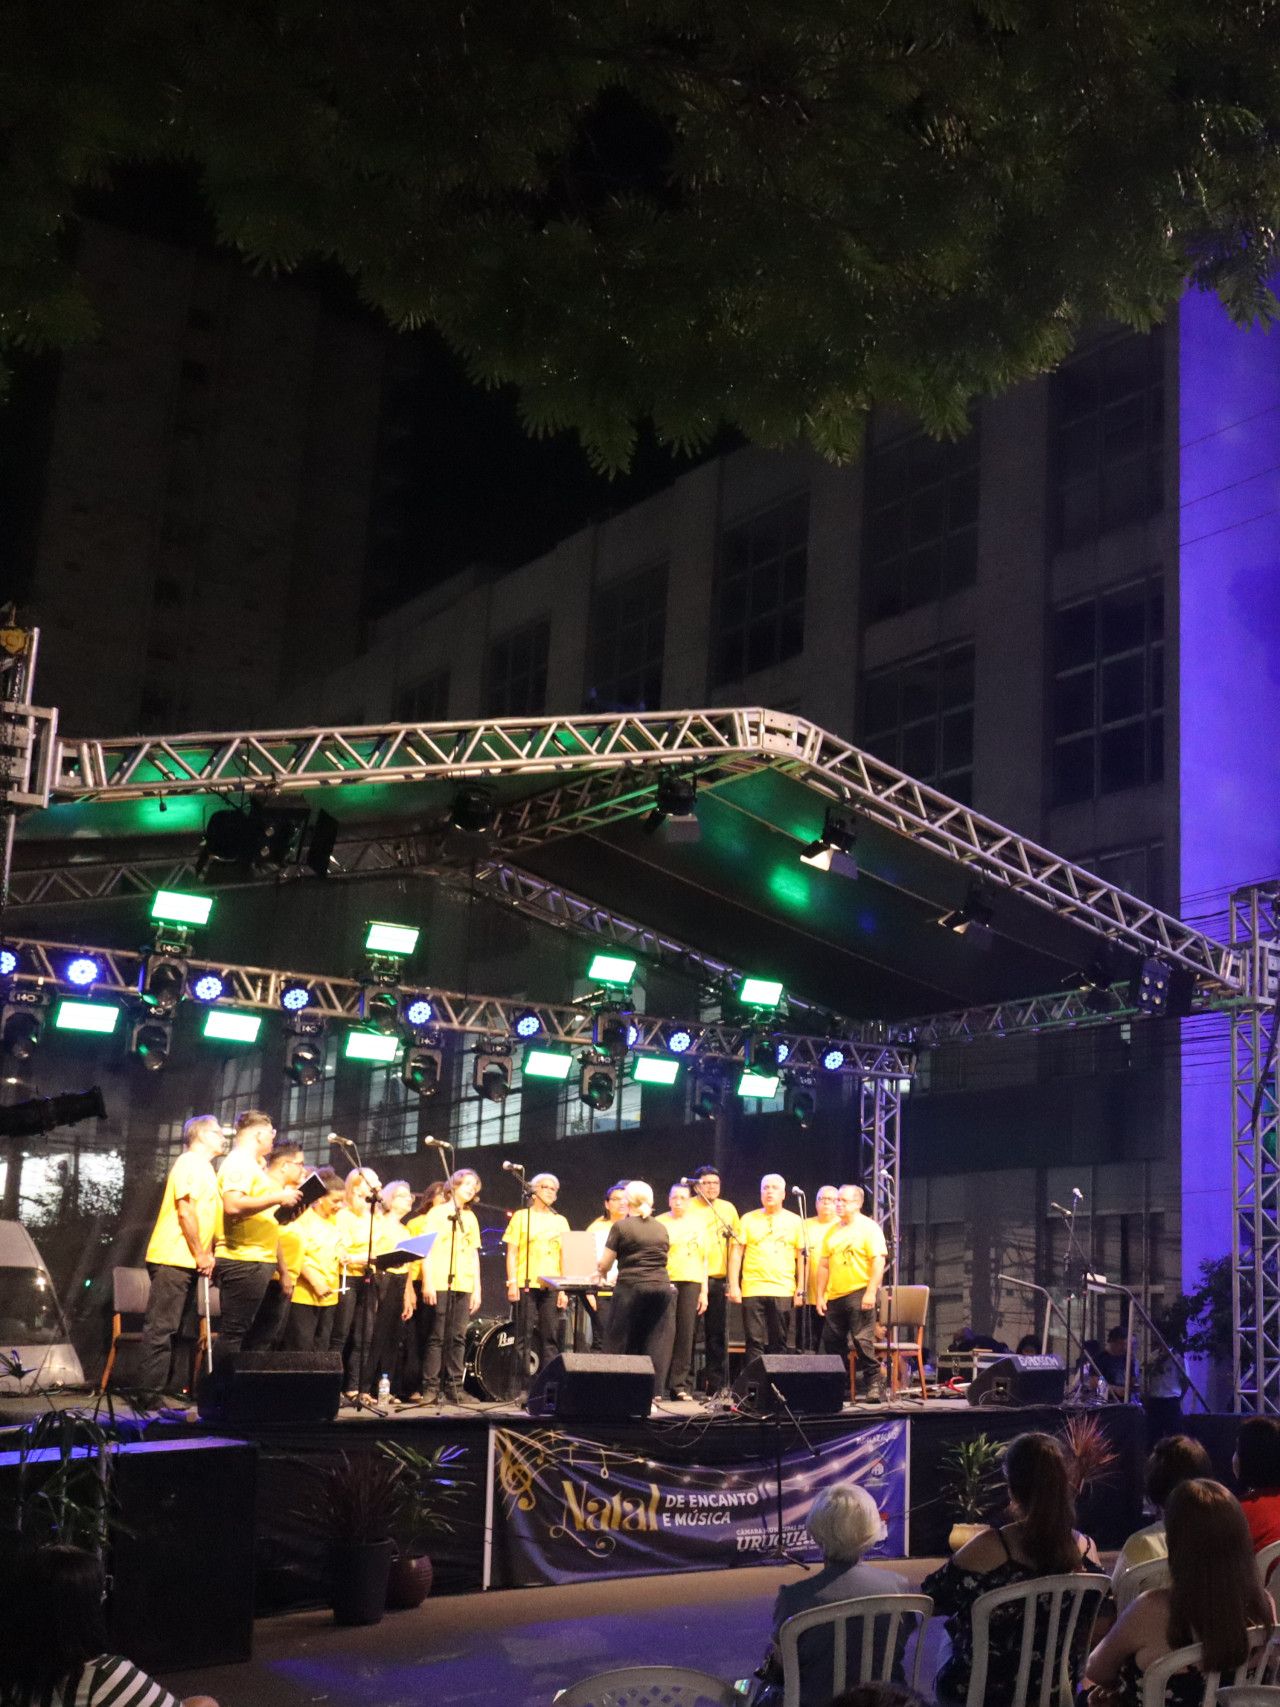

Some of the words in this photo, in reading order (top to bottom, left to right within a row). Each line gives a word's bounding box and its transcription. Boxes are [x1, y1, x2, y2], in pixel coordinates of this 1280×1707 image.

[558, 1480, 661, 1532] Natal
[664, 1494, 688, 1508] DE
[689, 1492, 758, 1508] ENCANTO
[663, 1513, 673, 1527] E
[675, 1510, 732, 1527] MÚSICA
